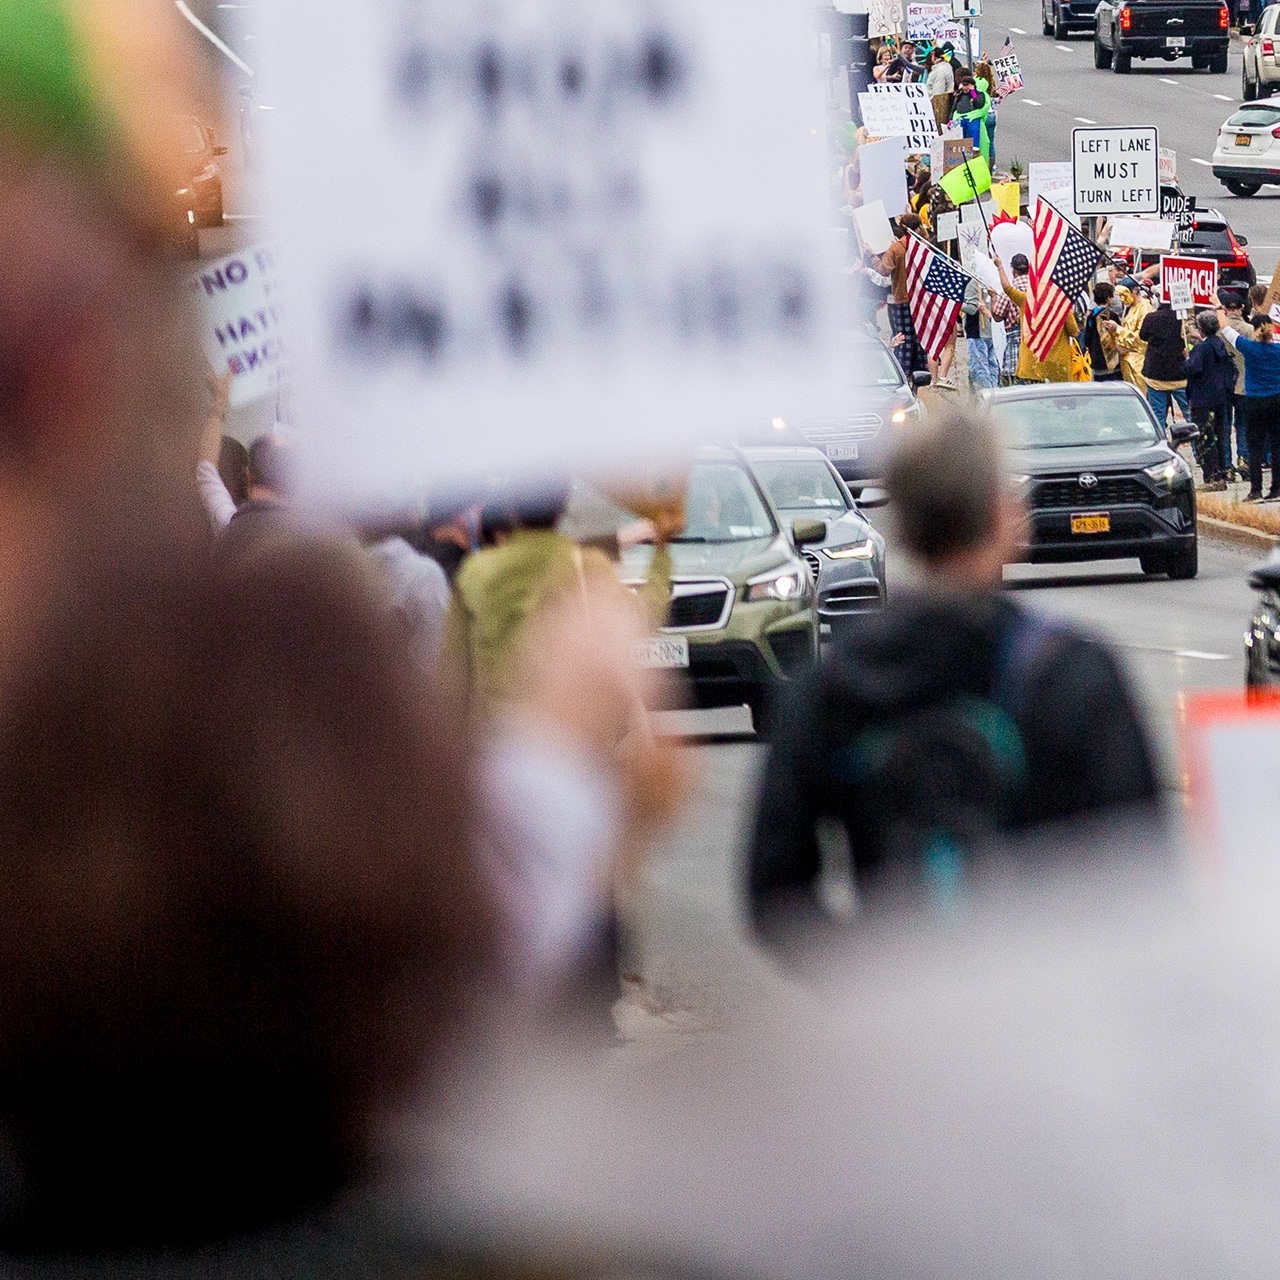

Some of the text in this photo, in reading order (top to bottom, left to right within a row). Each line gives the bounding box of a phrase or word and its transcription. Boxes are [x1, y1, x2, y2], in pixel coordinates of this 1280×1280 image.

[909, 6, 922, 15] HEY
[994, 55, 1017, 69] PREZ
[1081, 138, 1151, 153] LEFT LANE
[1094, 163, 1138, 180] MUST
[1080, 188, 1152, 203] TURN LEFT
[1163, 196, 1190, 212] DUDE
[200, 260, 249, 296] NO
